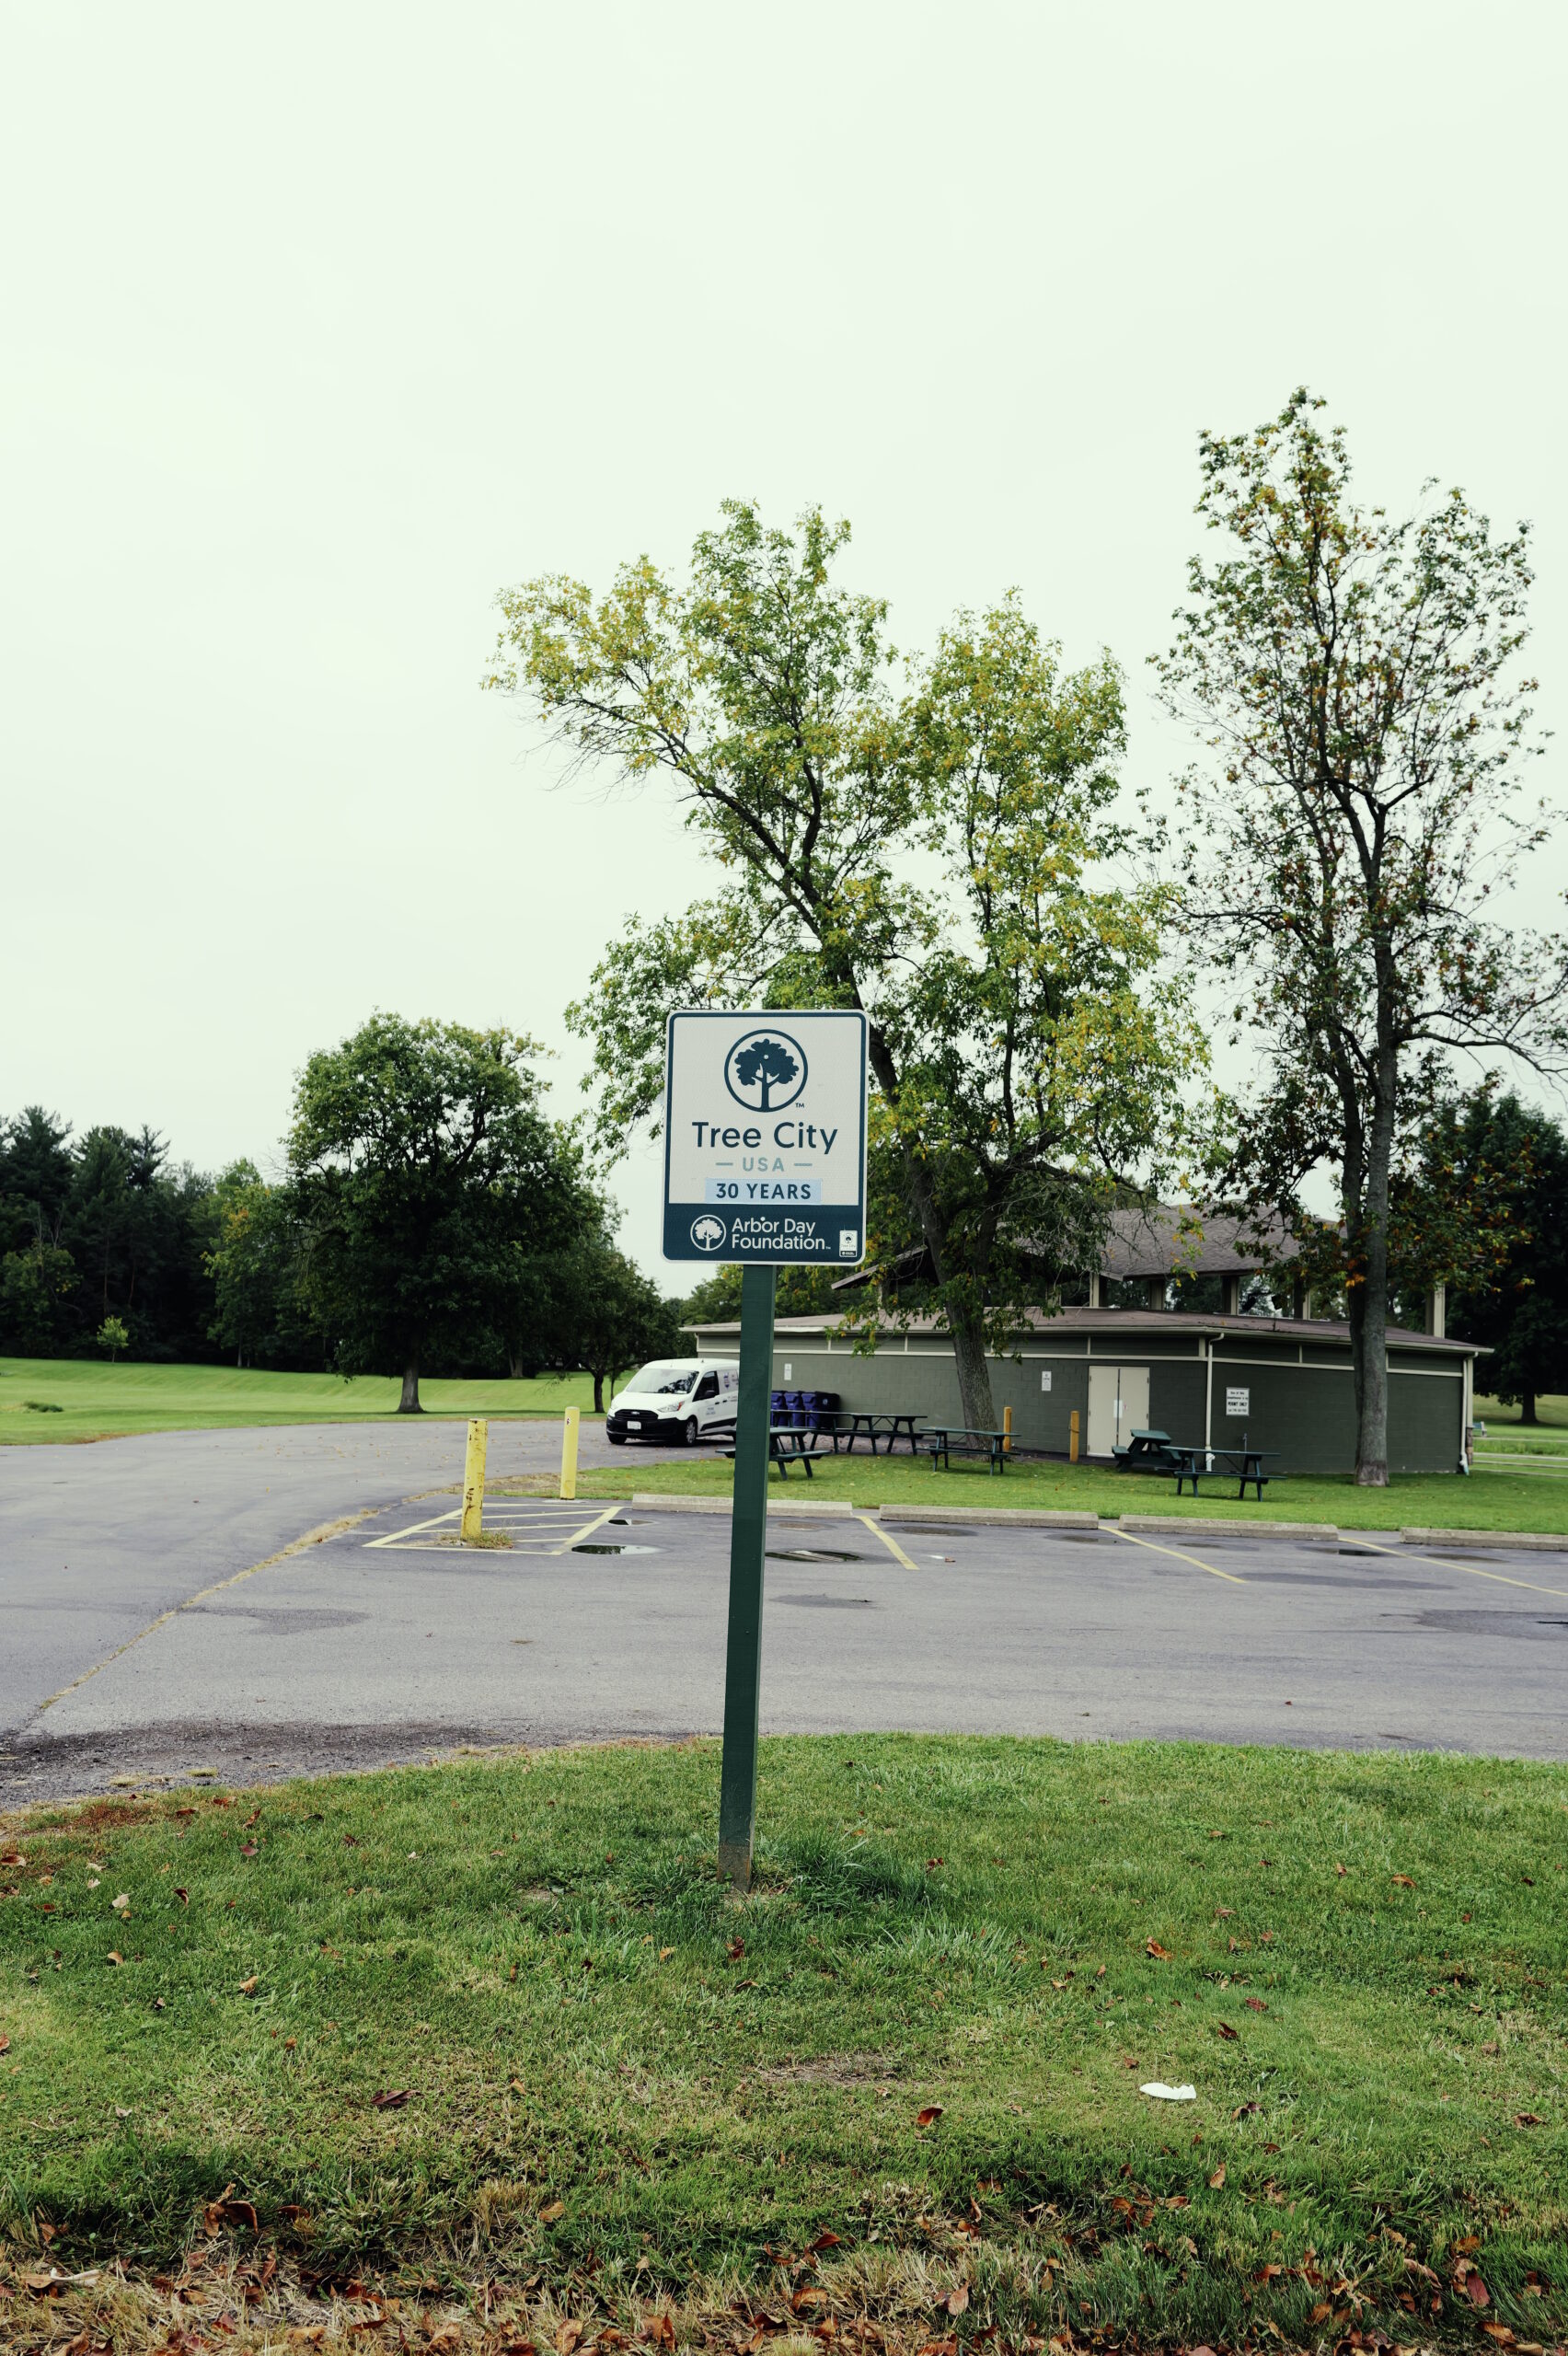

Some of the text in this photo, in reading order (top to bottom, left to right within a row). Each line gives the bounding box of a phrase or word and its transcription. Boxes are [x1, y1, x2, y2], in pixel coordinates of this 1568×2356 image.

[691, 1121, 838, 1155] Tree City
[742, 1157, 785, 1172] USA
[716, 1183, 812, 1200] 30 YEARS
[732, 1218, 816, 1237] Arbor Day
[732, 1234, 825, 1250] Foundation
